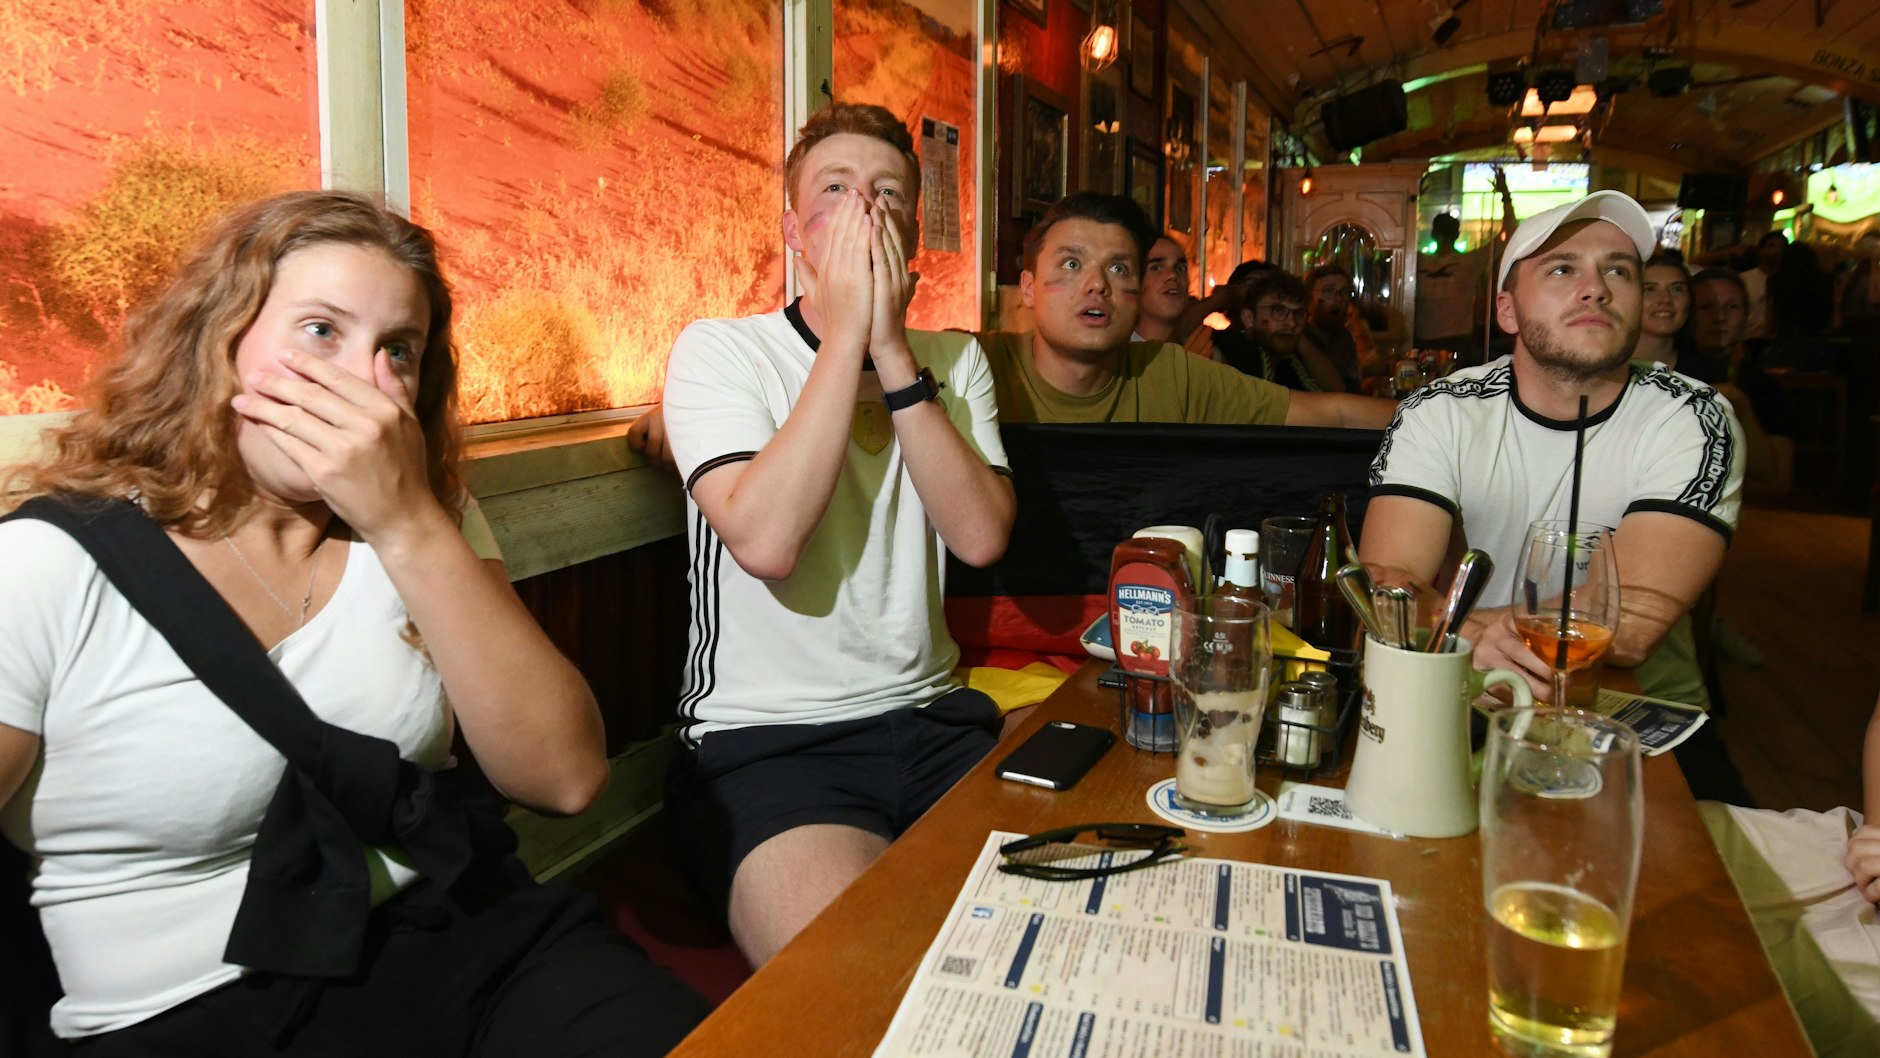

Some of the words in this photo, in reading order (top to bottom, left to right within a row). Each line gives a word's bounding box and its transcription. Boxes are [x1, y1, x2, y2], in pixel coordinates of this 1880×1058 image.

[1430, 382, 1482, 394] umbro
[1700, 438, 1727, 492] umbro
[1262, 569, 1295, 584] UINNESS
[1118, 588, 1172, 605] HELLMANN'S
[1123, 614, 1165, 627] TOMATO
